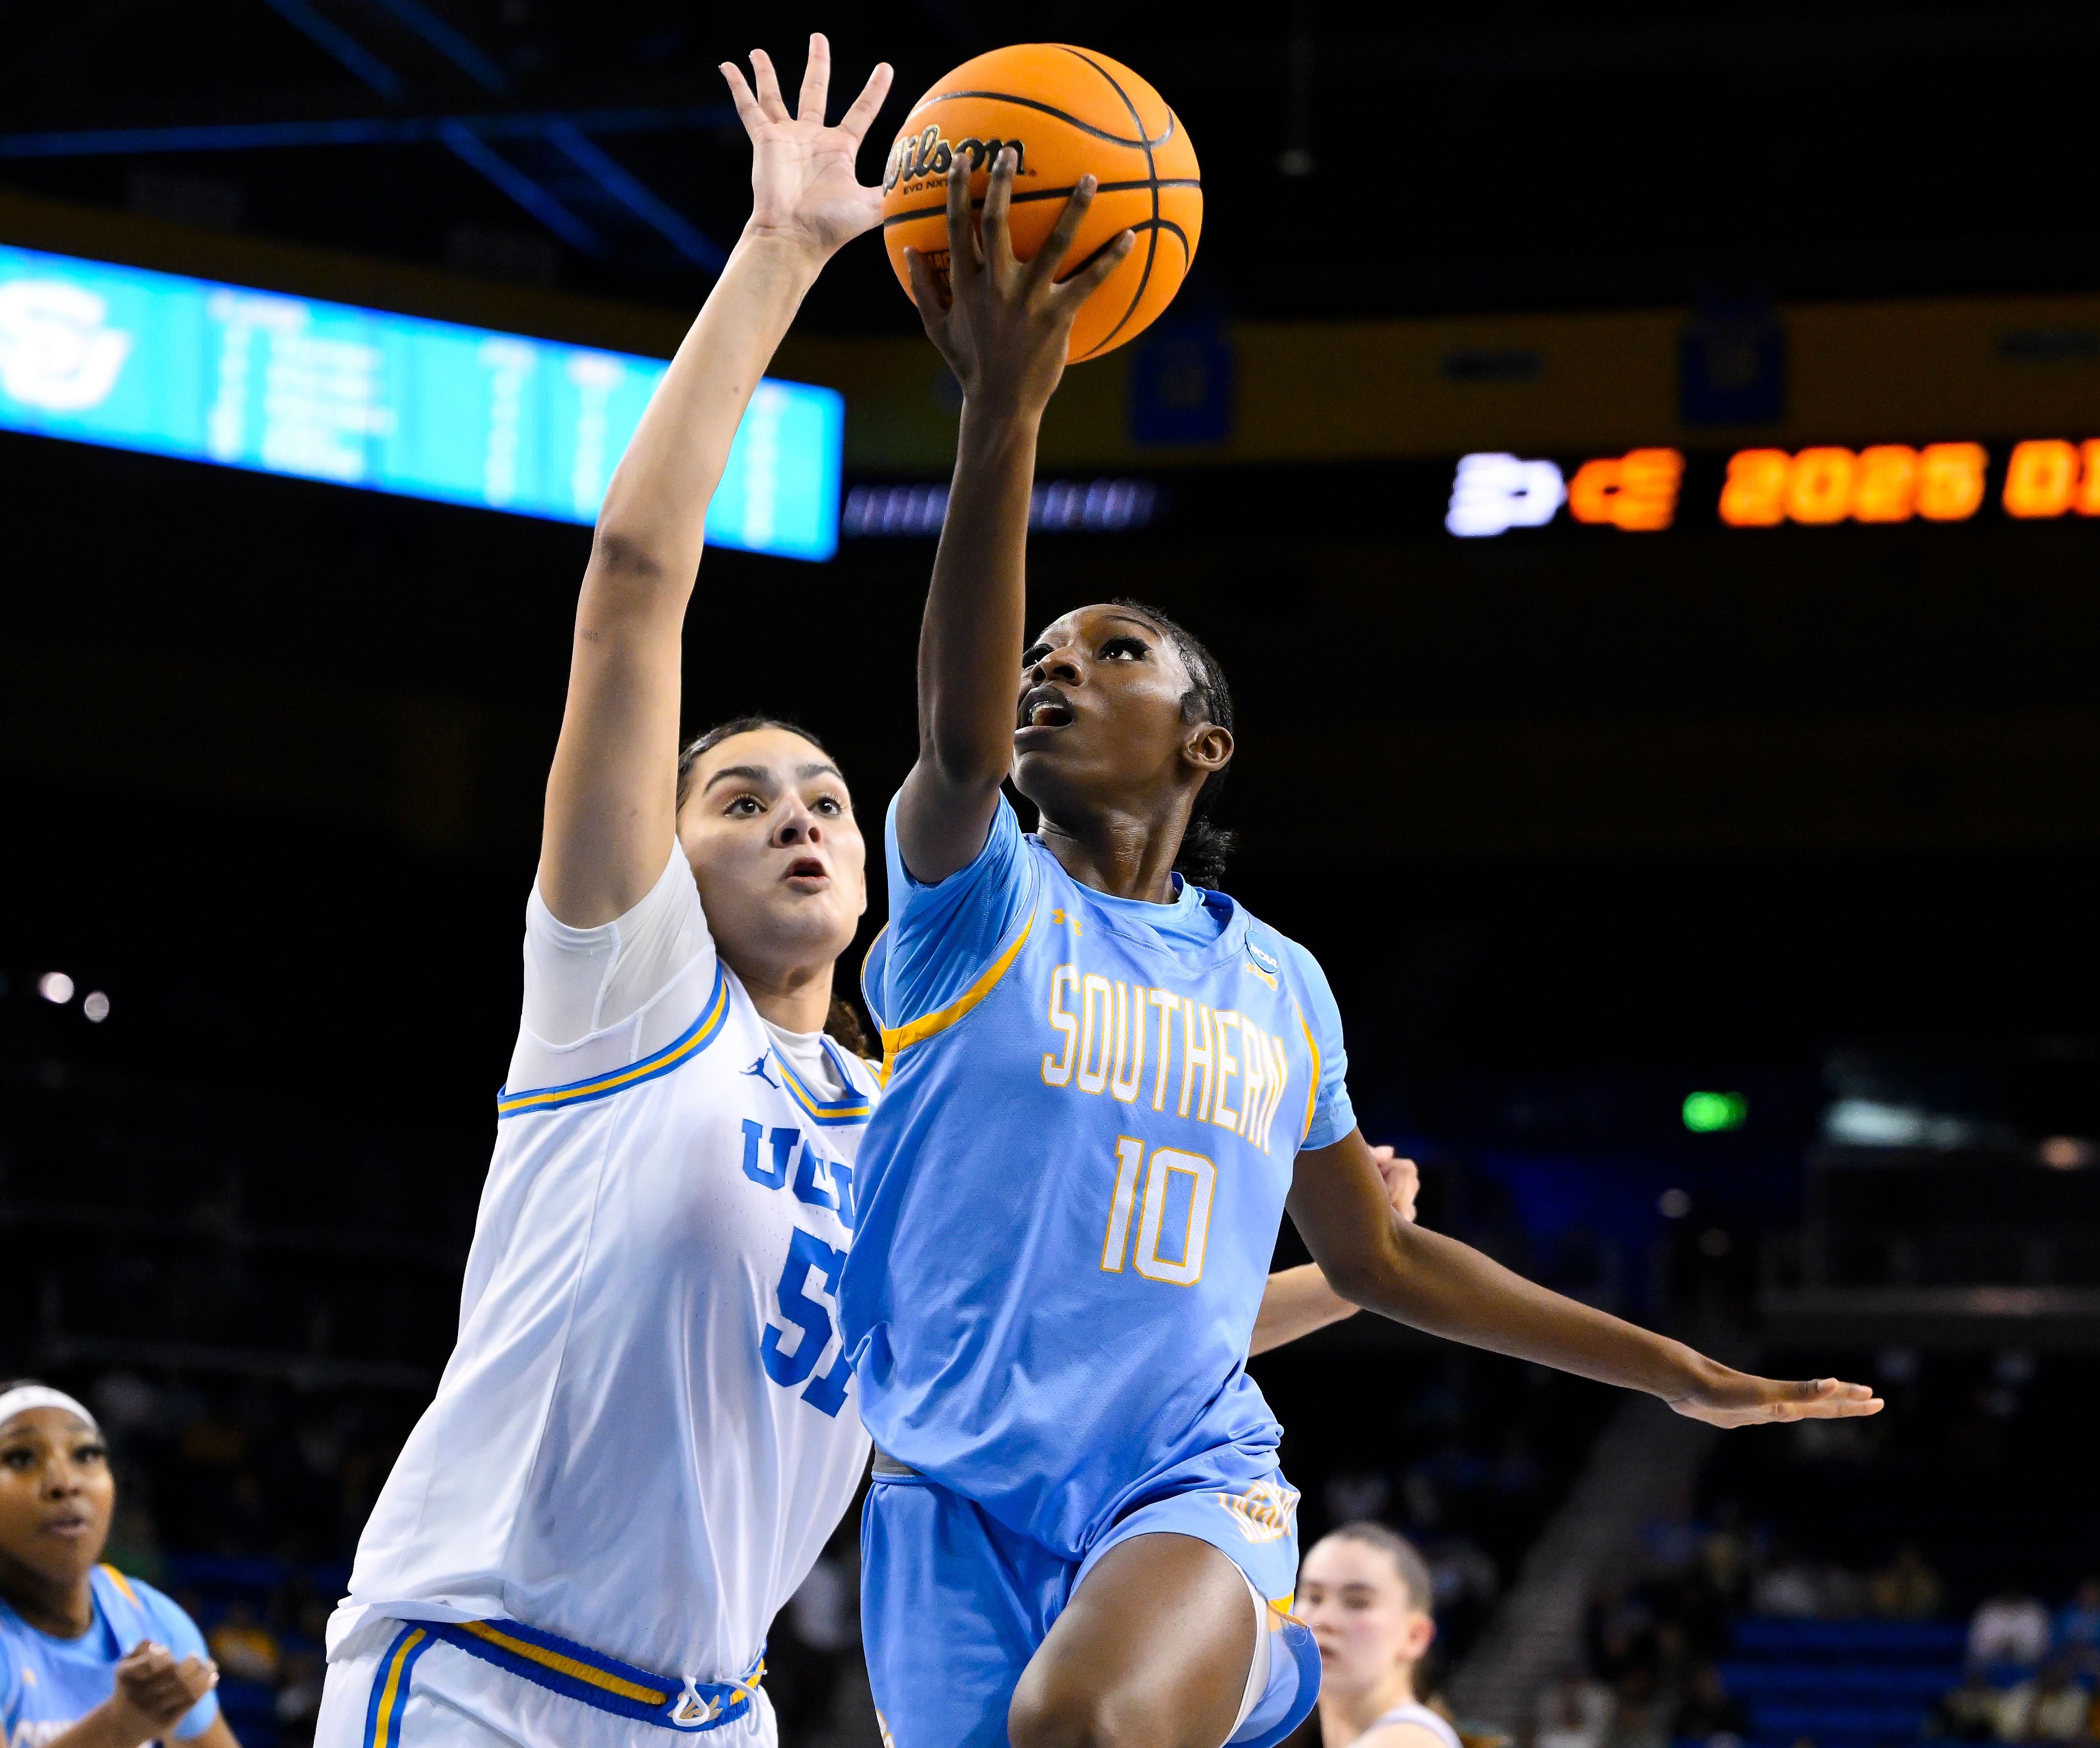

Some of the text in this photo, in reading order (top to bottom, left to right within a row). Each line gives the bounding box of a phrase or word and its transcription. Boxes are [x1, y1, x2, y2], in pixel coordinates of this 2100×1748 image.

[1250, 942, 1277, 969] NCAA
[1041, 963, 1288, 1156] SOUTHERN
[1100, 1134, 1217, 1287] 10
